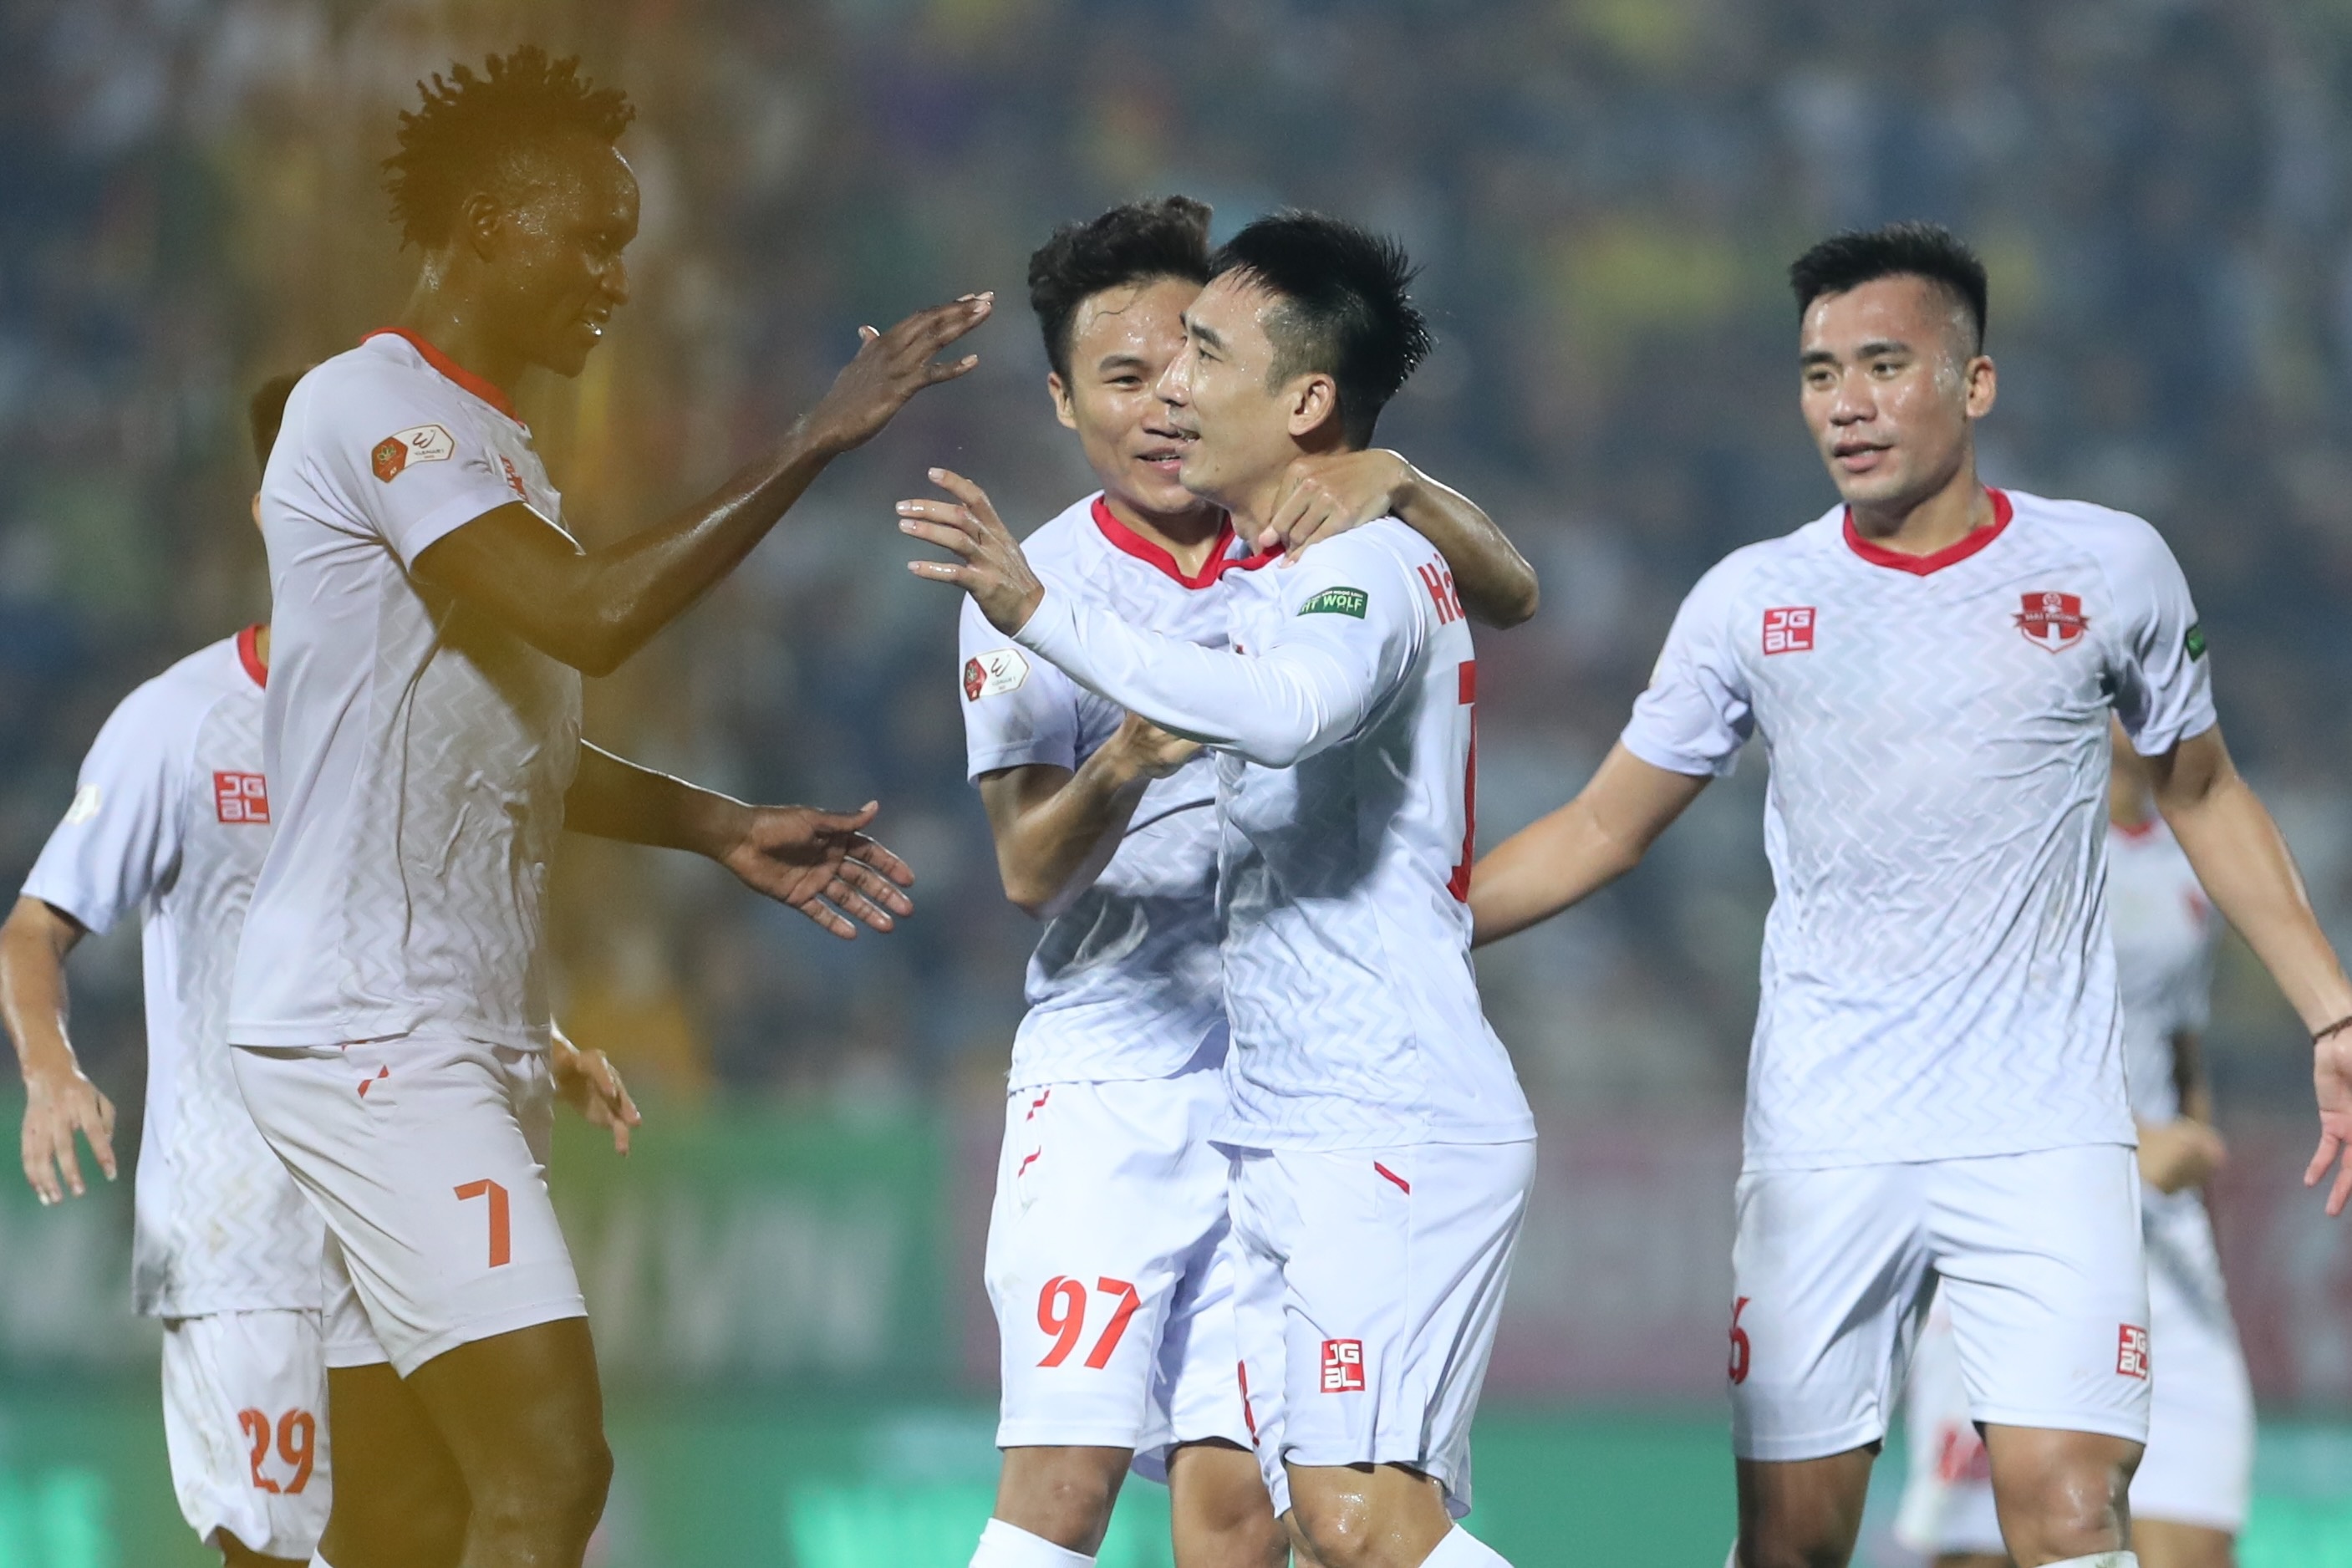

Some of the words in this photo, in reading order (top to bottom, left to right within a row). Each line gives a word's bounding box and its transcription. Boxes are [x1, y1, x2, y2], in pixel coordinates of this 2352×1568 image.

[1323, 594, 1363, 612] WOLF
[453, 1178, 511, 1269] 7
[1036, 1275, 1141, 1370] 97
[1324, 1366, 1362, 1389] BL
[1325, 1342, 1360, 1365] JG
[238, 1408, 316, 1494] 29
